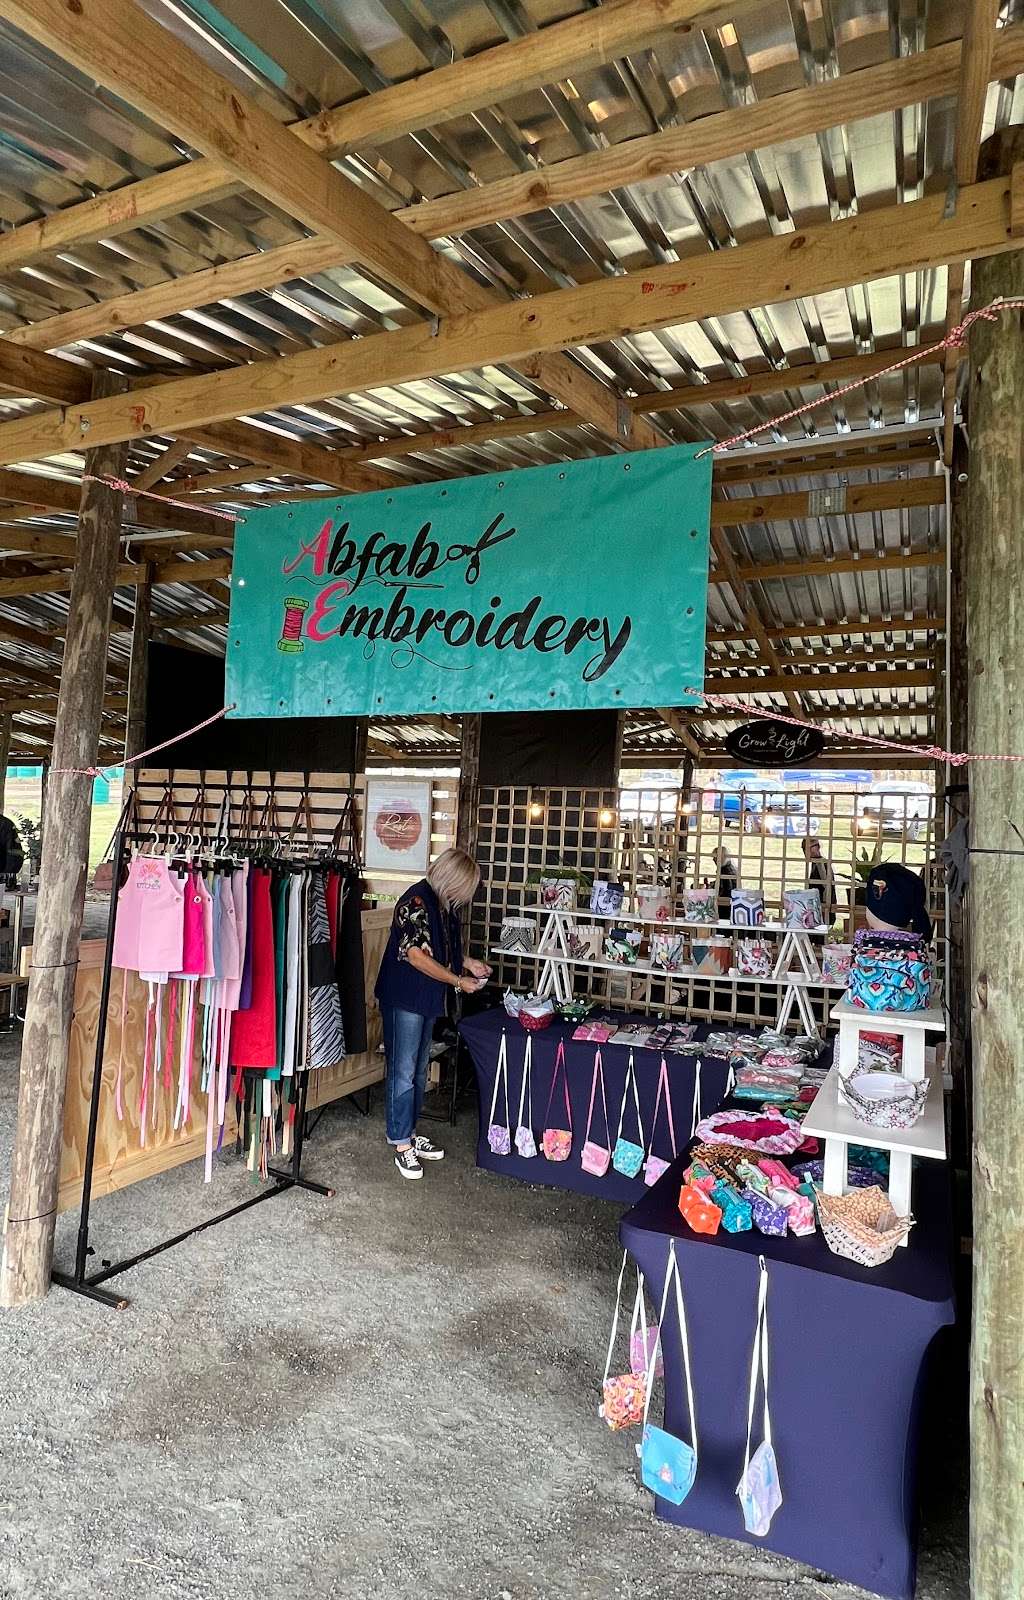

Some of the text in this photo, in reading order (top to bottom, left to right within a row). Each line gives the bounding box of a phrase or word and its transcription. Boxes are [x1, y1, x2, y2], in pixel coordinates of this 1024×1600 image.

[283, 519, 441, 596] Abfab
[306, 582, 632, 681] Embroidery
[739, 734, 768, 748] Grow
[776, 729, 810, 758] Light
